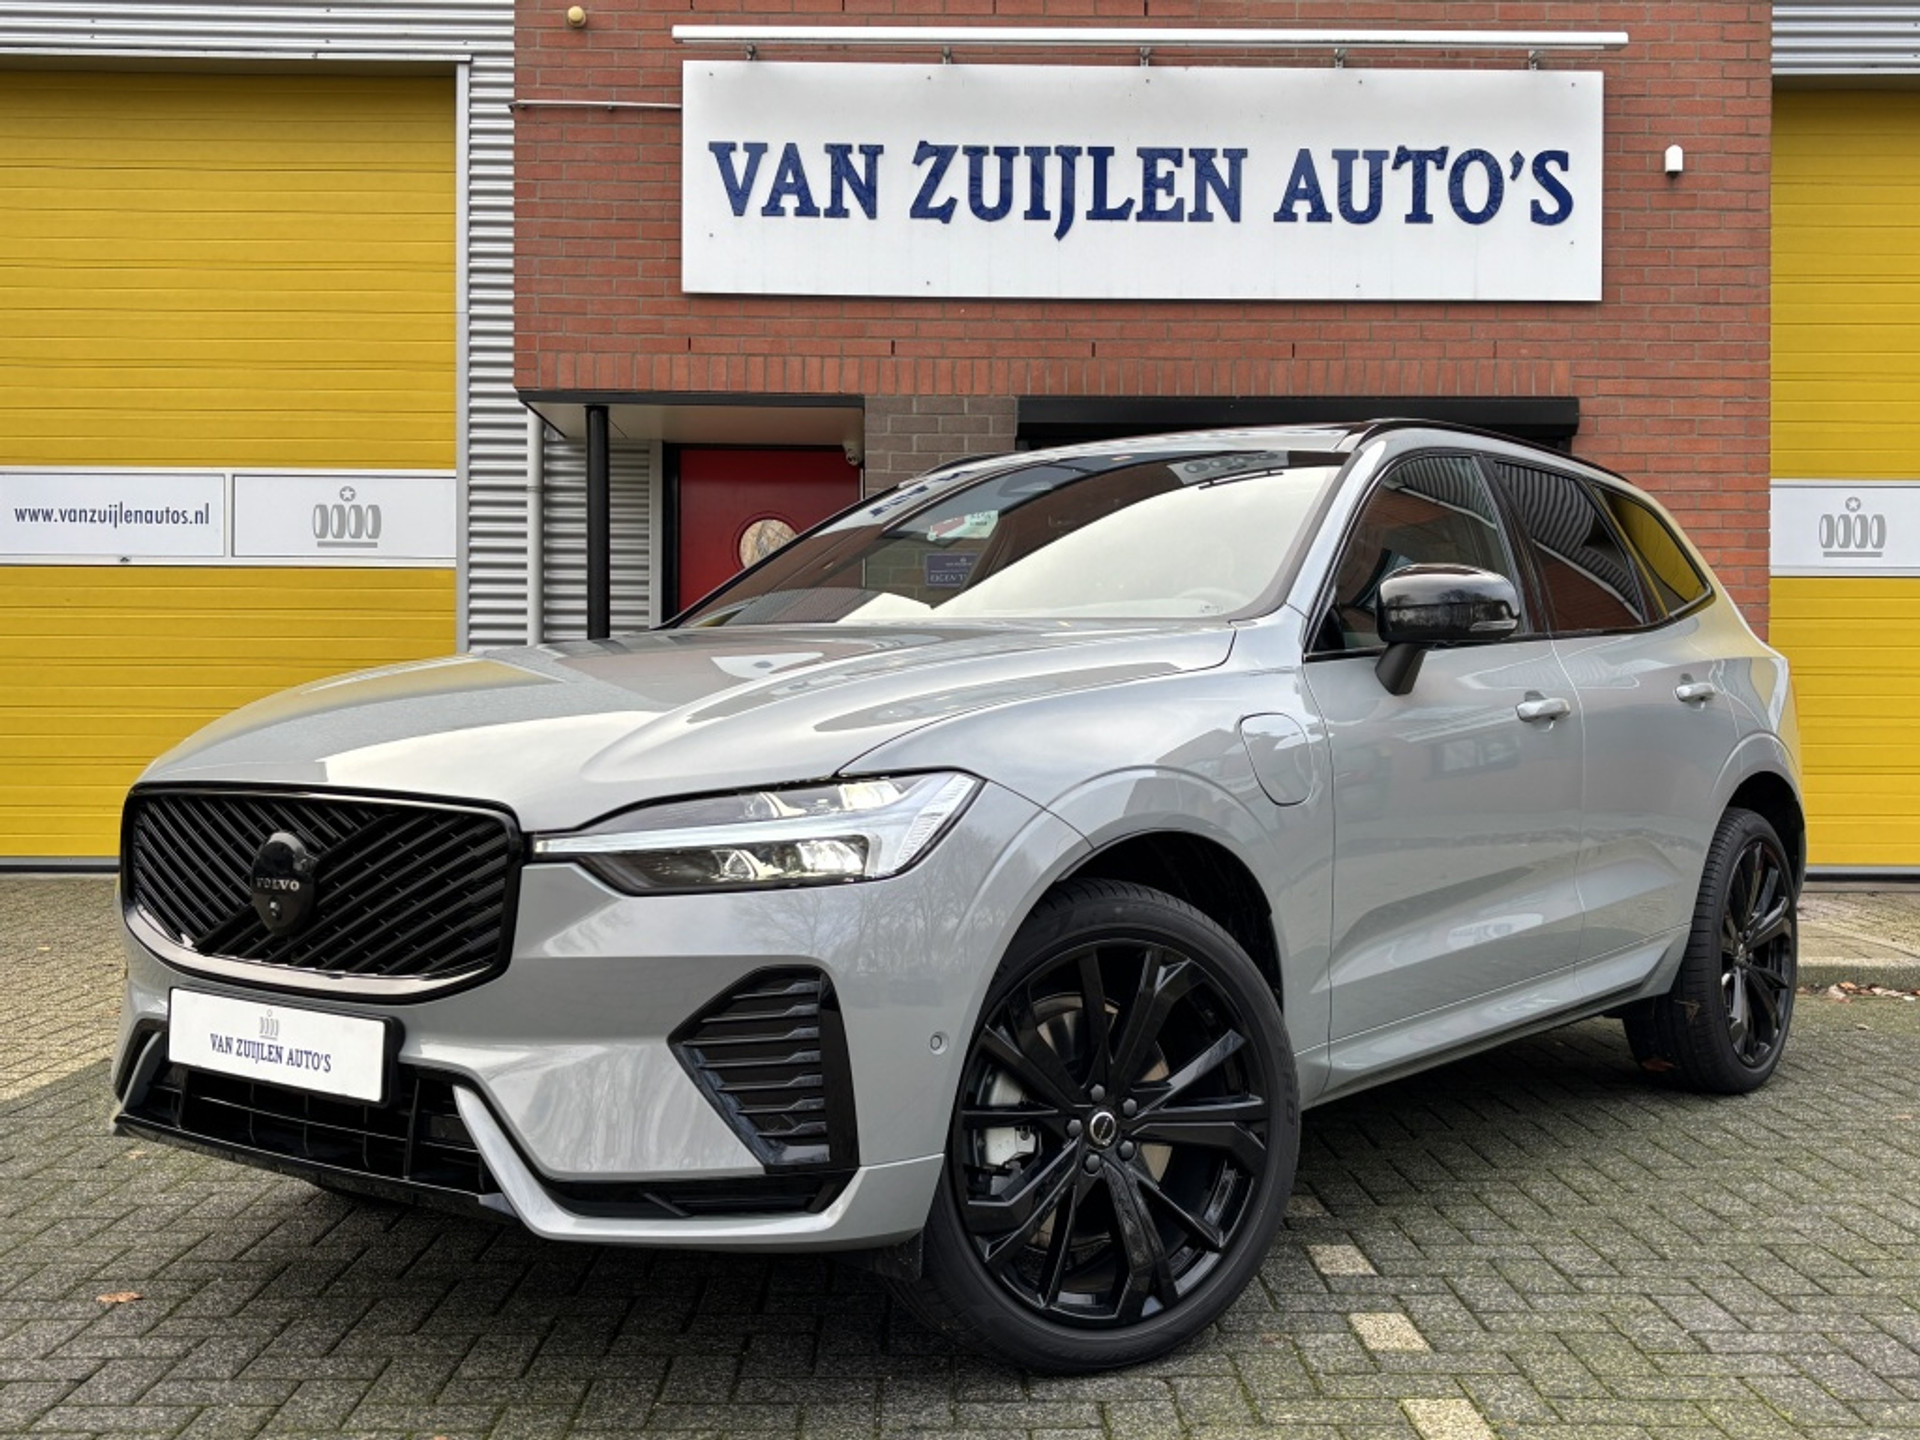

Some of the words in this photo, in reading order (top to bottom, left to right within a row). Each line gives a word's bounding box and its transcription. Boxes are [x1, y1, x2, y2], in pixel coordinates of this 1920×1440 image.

[708, 141, 884, 220] VAN
[909, 140, 1248, 242] ZUIJLEN
[1273, 145, 1574, 226] AUTO'S
[14, 501, 210, 529] www.vanzuijlenautos.nl
[255, 877, 301, 892] VOLVO
[210, 1033, 234, 1054] VAN
[235, 1038, 284, 1064] ZUIJLEN
[286, 1049, 332, 1073] AUTO'S
